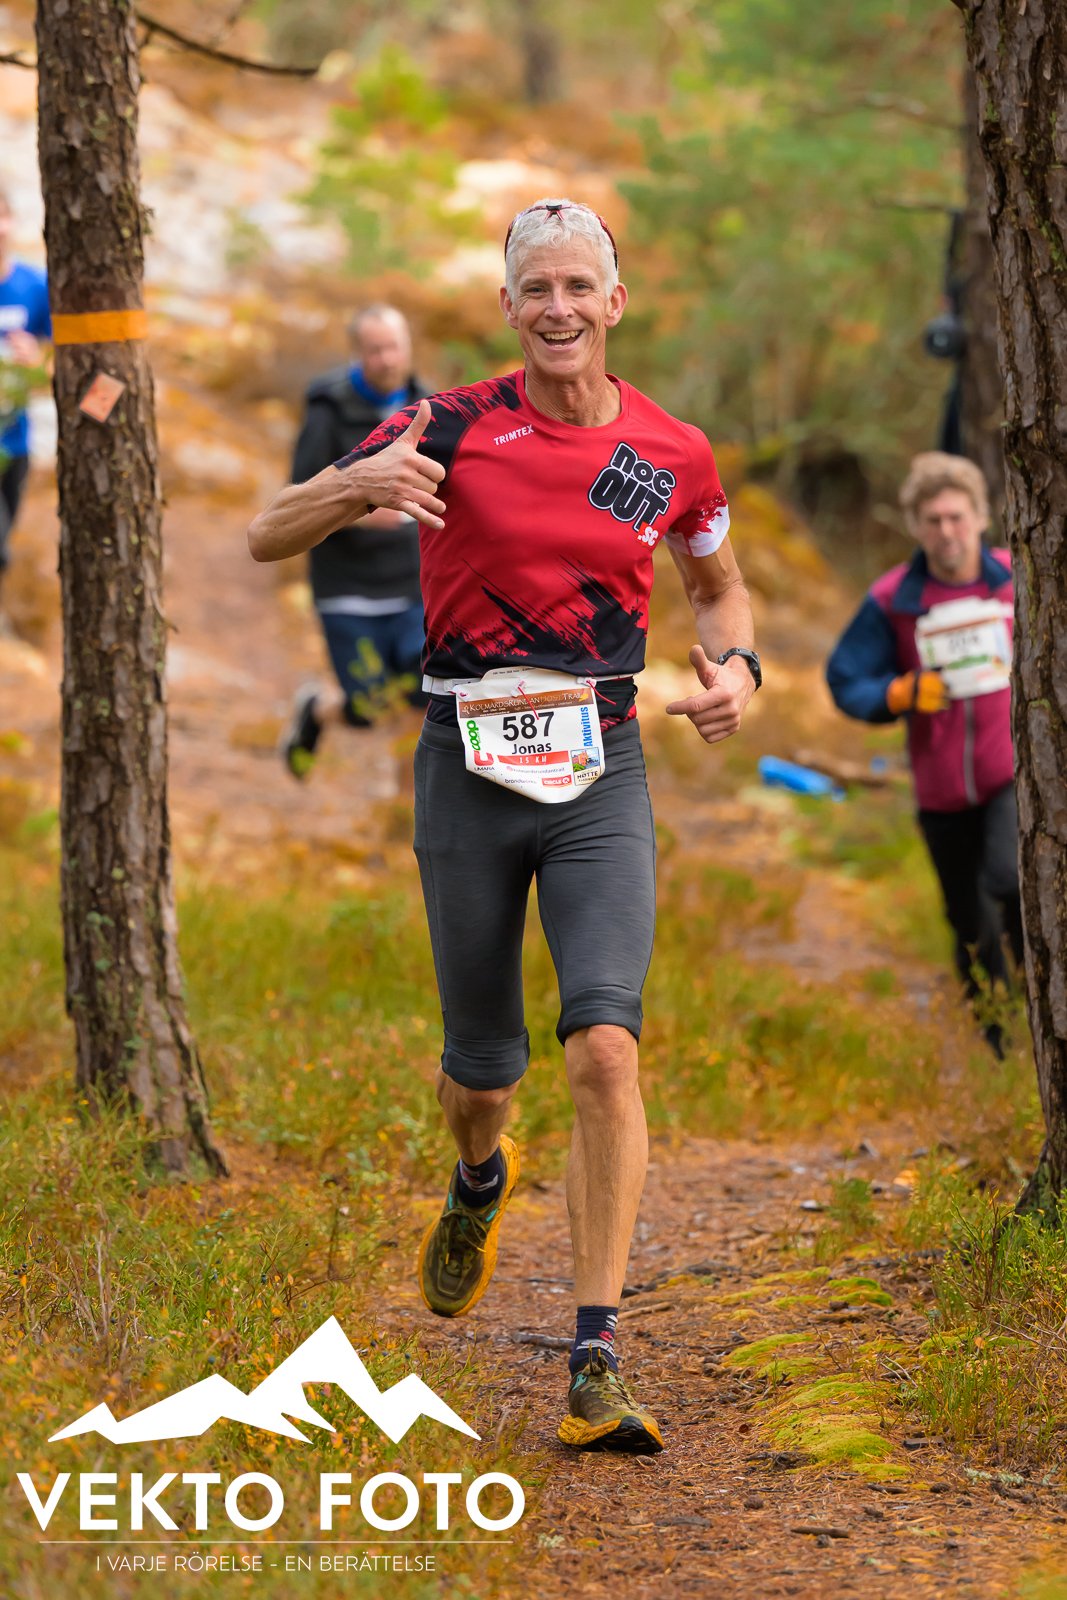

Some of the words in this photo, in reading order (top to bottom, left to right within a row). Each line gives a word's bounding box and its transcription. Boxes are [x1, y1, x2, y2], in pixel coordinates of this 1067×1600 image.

[493, 424, 535, 446] TRIMTEX
[588, 467, 670, 532] OUT
[467, 719, 481, 751] coop
[502, 711, 555, 742] 587
[511, 742, 552, 755] Jonas
[519, 757, 530, 765] 15
[535, 755, 547, 764] KM
